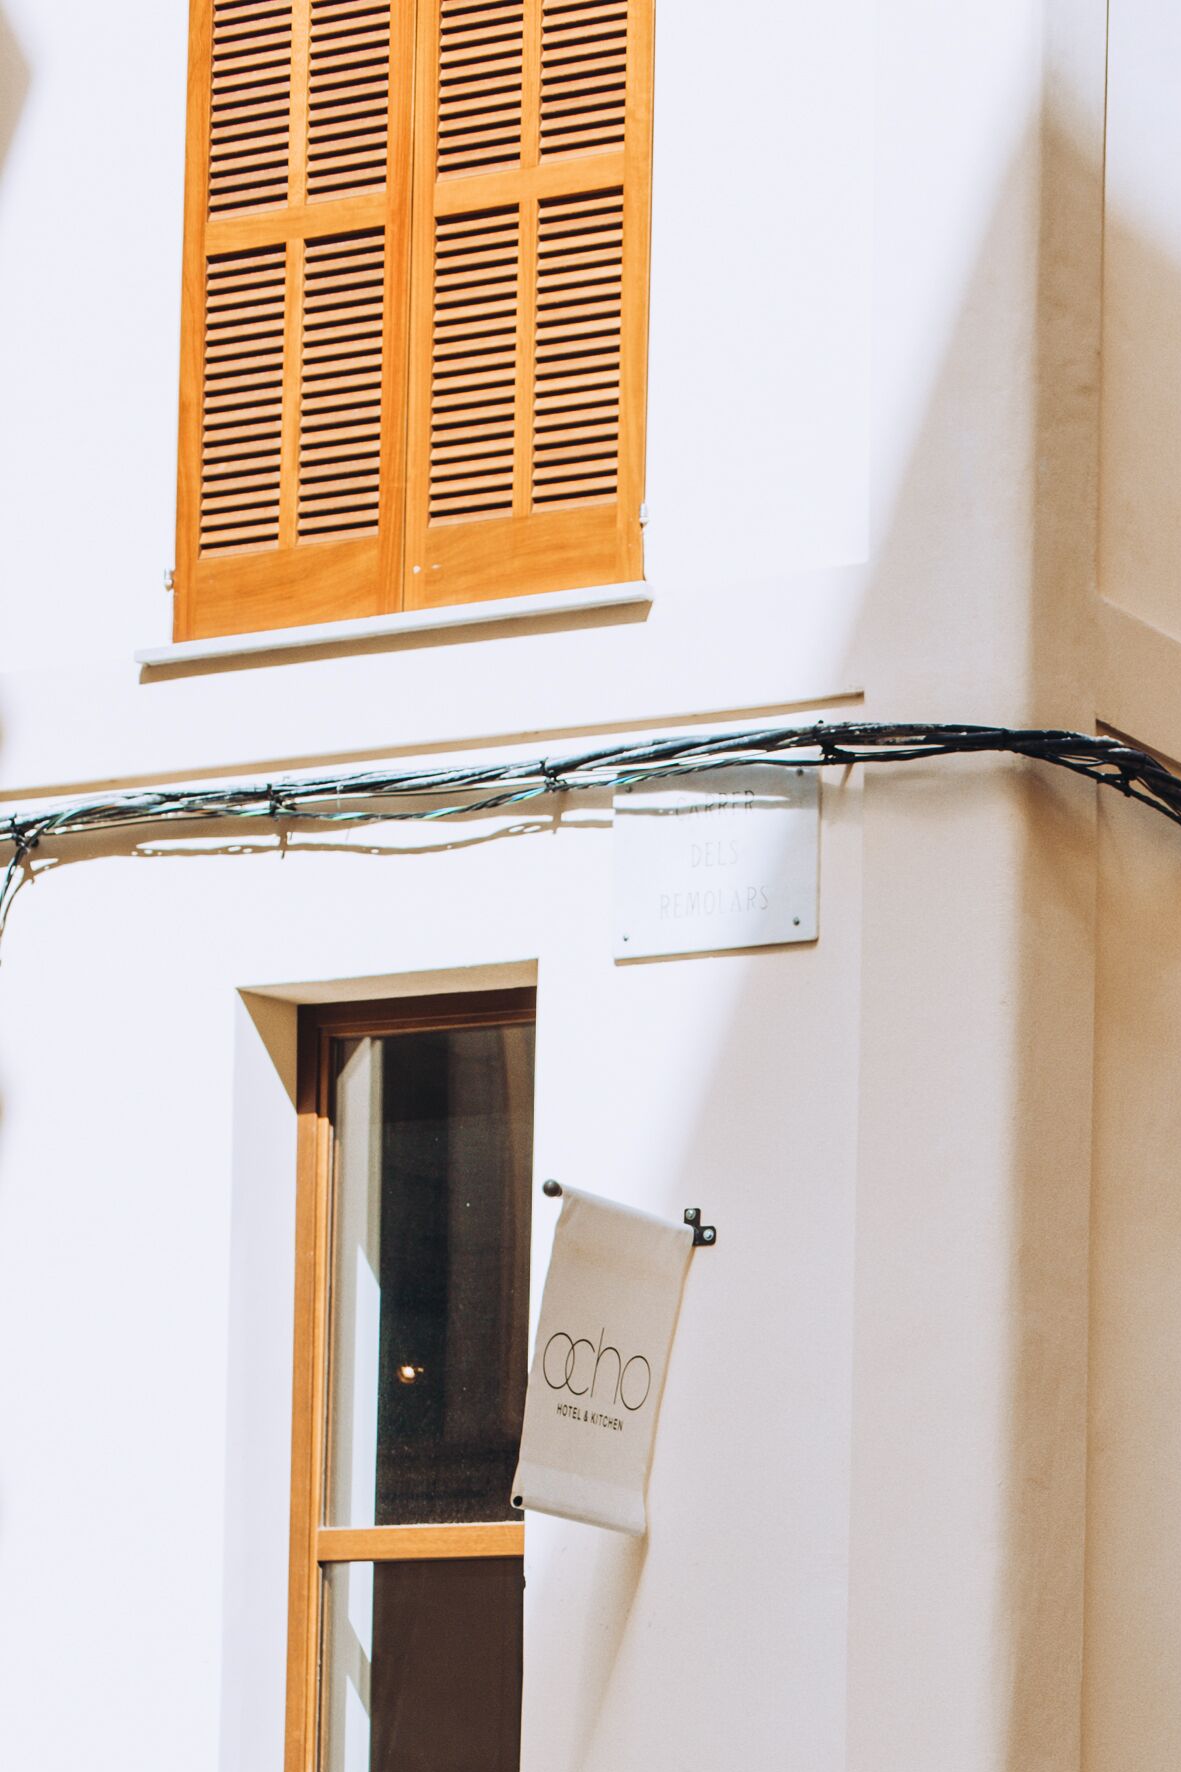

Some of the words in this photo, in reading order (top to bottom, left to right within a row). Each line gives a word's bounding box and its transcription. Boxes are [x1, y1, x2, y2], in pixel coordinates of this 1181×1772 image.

[690, 840, 739, 868] DELS
[659, 886, 769, 920] REMOLARS
[557, 1403, 581, 1421] HOTEL
[583, 1410, 588, 1422] &
[591, 1412, 624, 1431] KITCHEN
